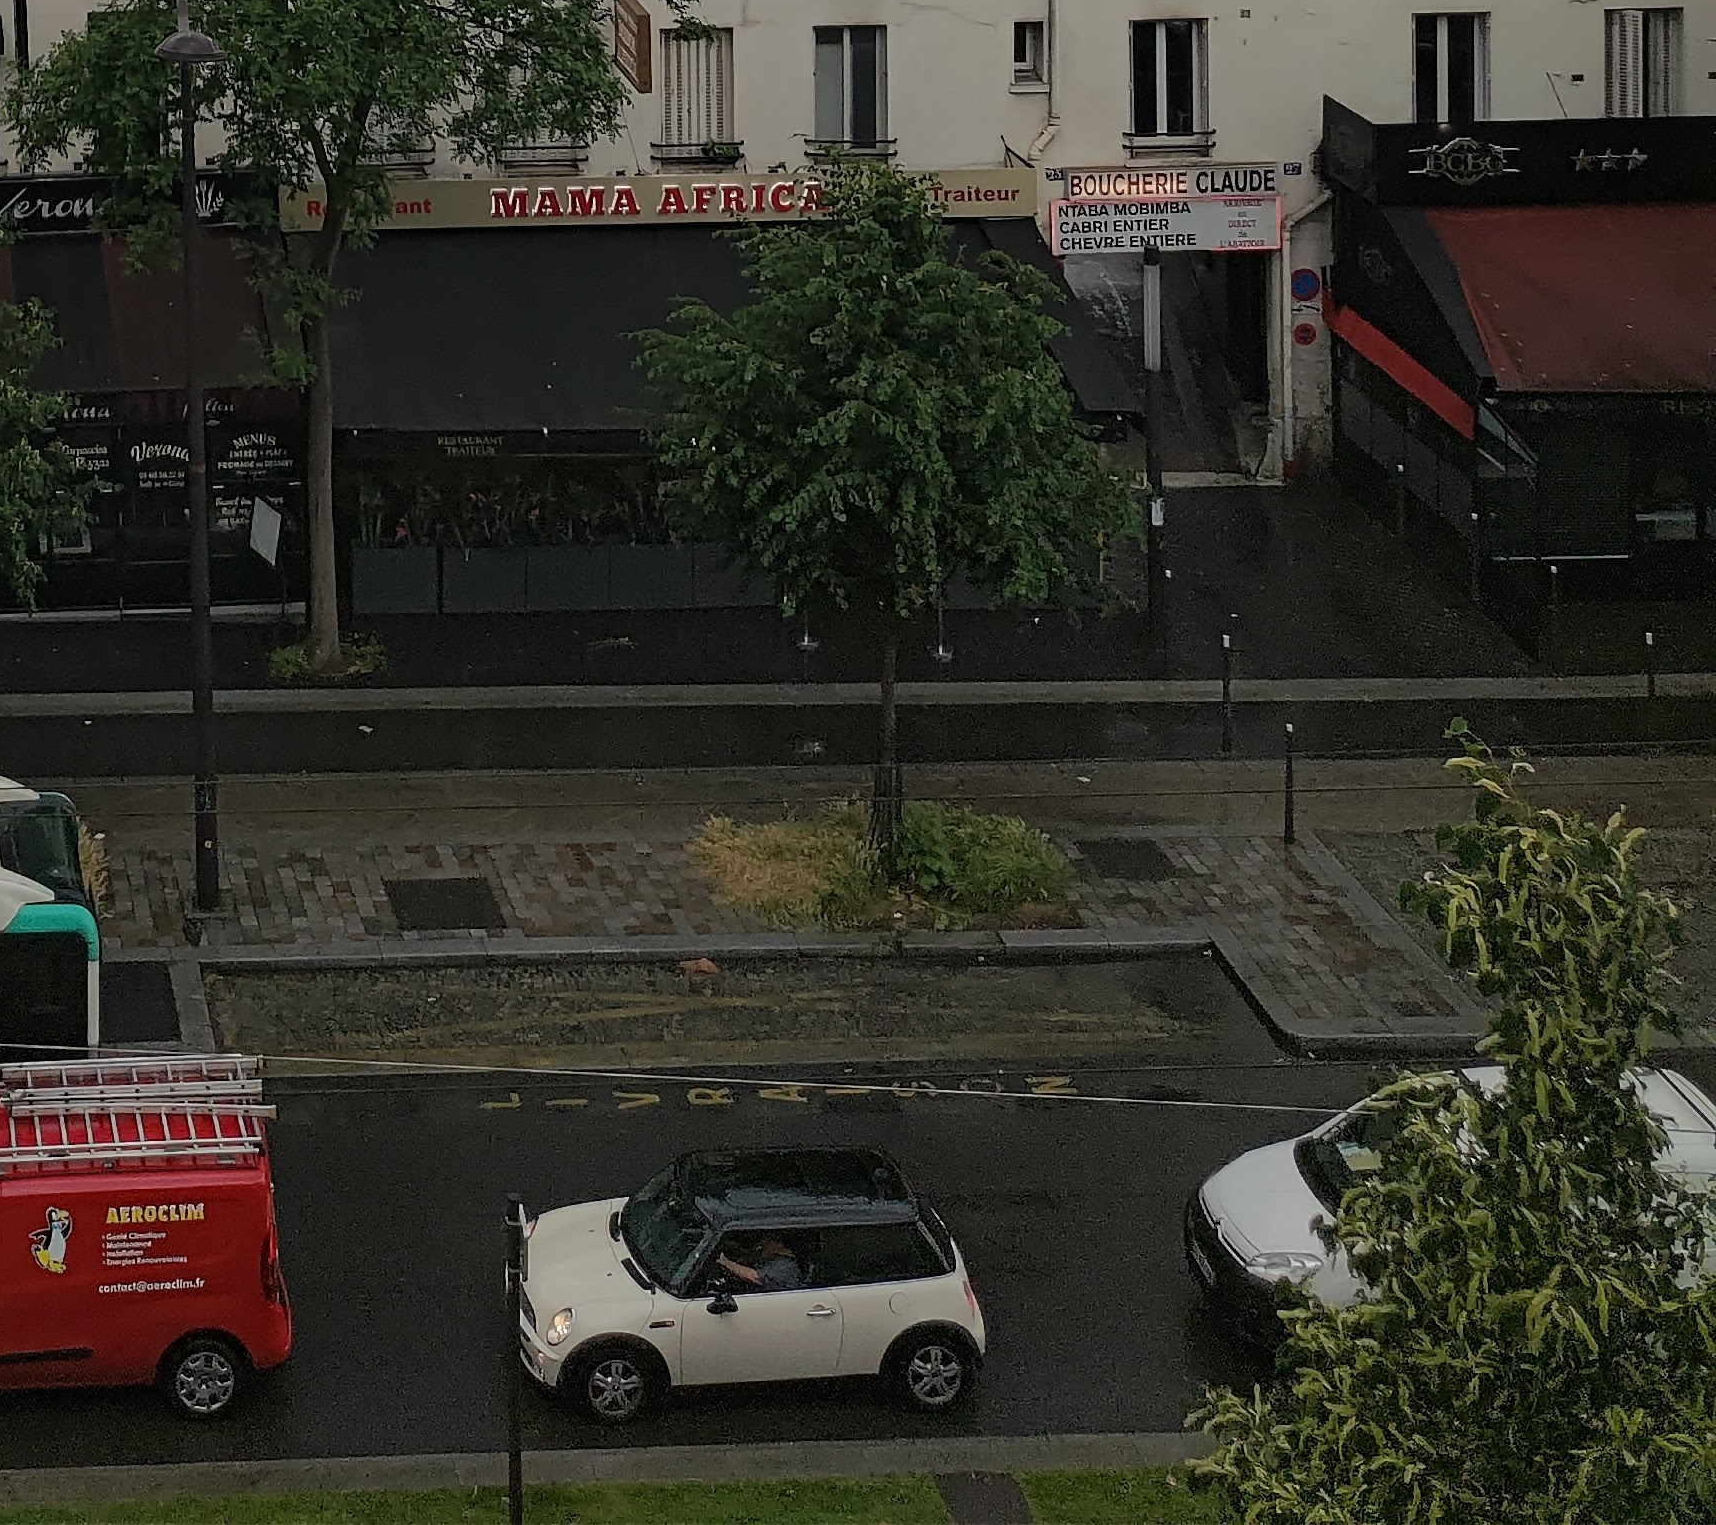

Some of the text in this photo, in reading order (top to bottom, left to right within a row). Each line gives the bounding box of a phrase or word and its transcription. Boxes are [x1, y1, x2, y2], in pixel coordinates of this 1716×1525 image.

[1070, 172, 1188, 197] BOUCHERIE
[1195, 169, 1276, 193] CLAUDE
[490, 181, 831, 219] MAMA AFRICA
[927, 185, 1020, 203] Traiteur
[1058, 200, 1192, 219] NTABA MOBIMBA
[1059, 218, 1170, 235] CABRI ENTIER
[1059, 233, 1198, 251] CHEVRE ENTIERE
[130, 441, 190, 463] Verona
[106, 1202, 205, 1224] AEROCLIM
[98, 1277, 206, 1294] contact@aeroclim.fr
